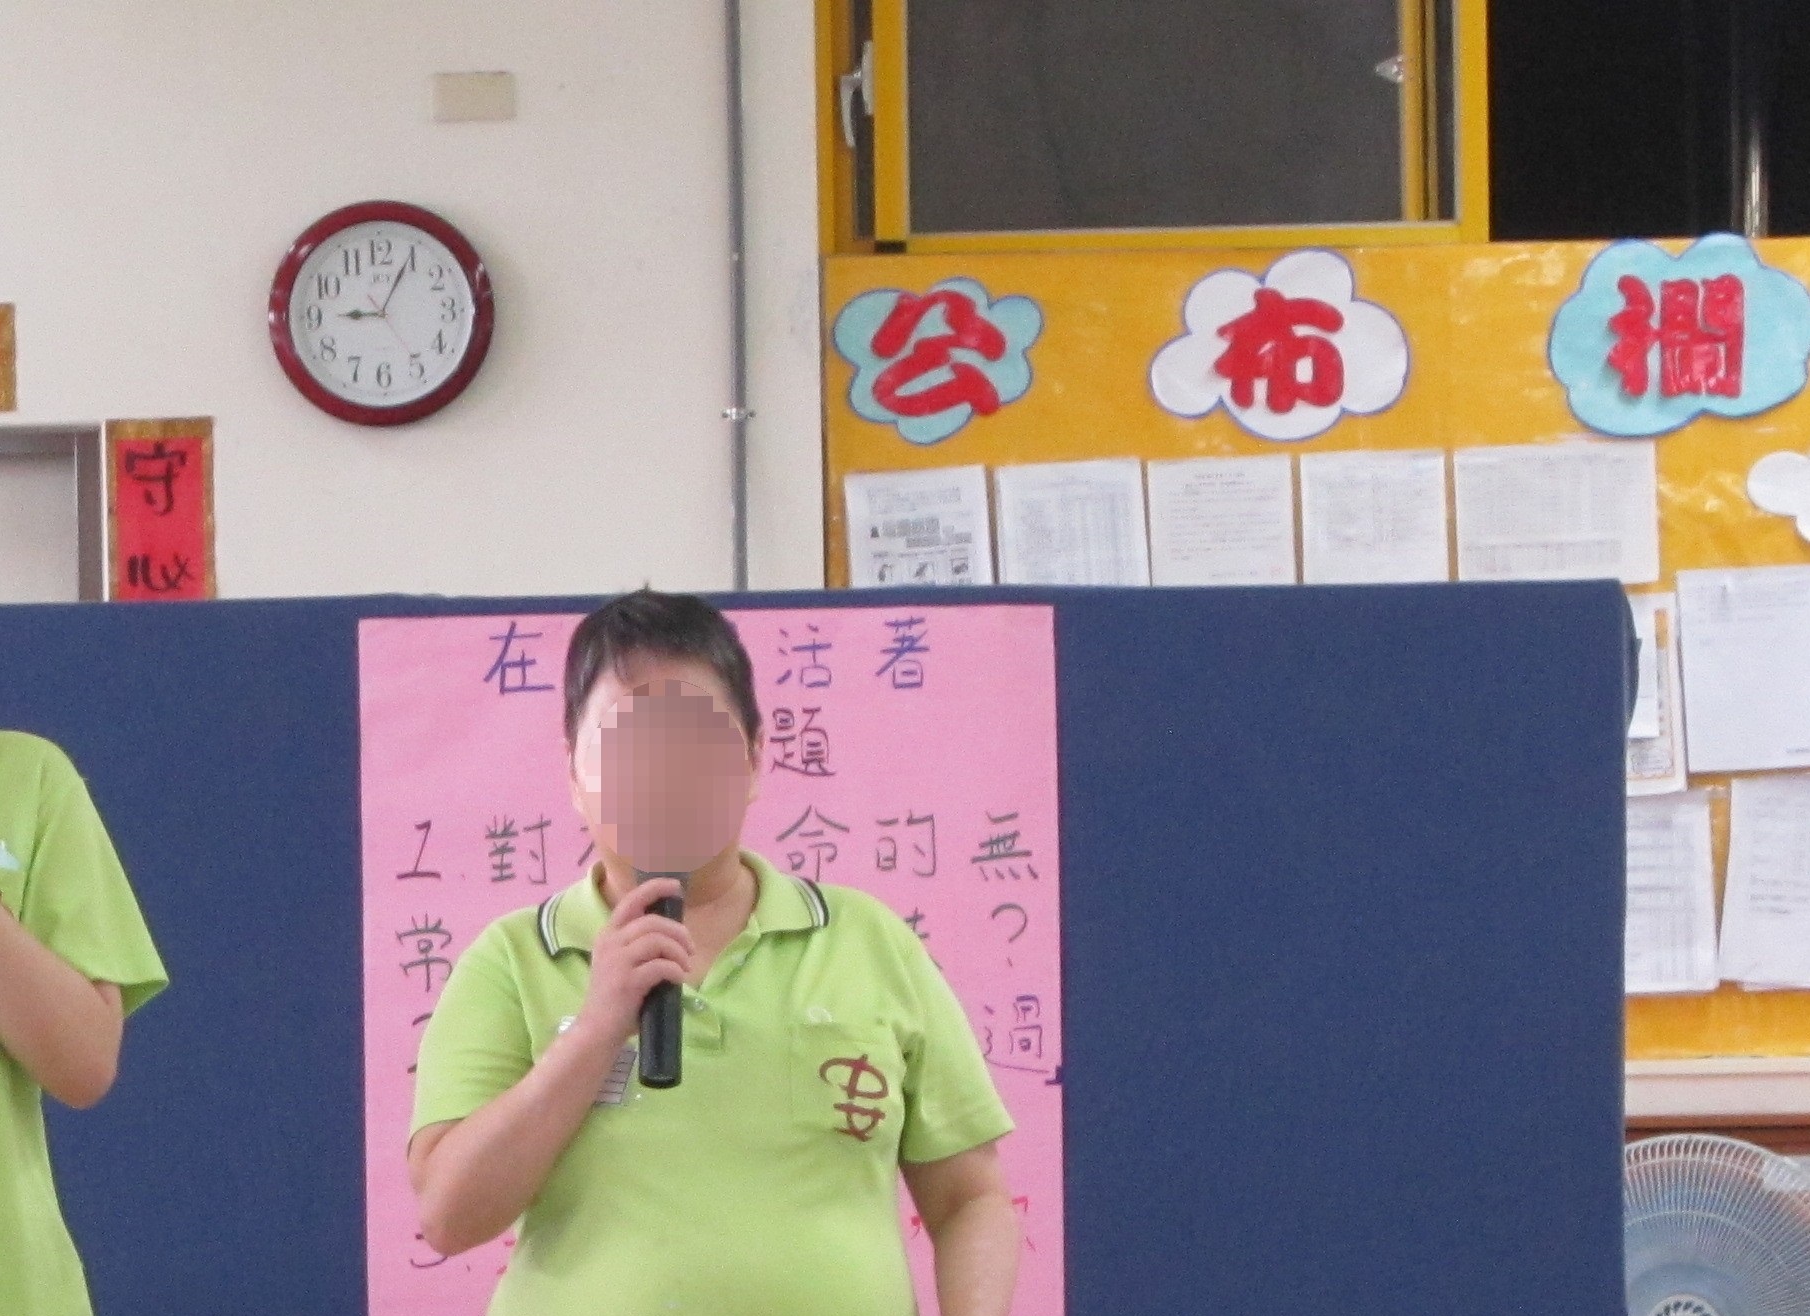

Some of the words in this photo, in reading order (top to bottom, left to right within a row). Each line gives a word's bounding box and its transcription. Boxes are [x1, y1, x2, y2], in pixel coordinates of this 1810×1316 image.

[343, 248, 361, 276] 11
[370, 239, 392, 266] 12
[317, 273, 340, 300] 10
[429, 264, 445, 291] 2
[307, 304, 322, 330] 9
[441, 297, 456, 323] 3
[320, 336, 337, 362] 8
[432, 329, 447, 355] 4
[348, 356, 362, 383] 7
[376, 362, 391, 388] 6
[409, 352, 425, 380] 5
